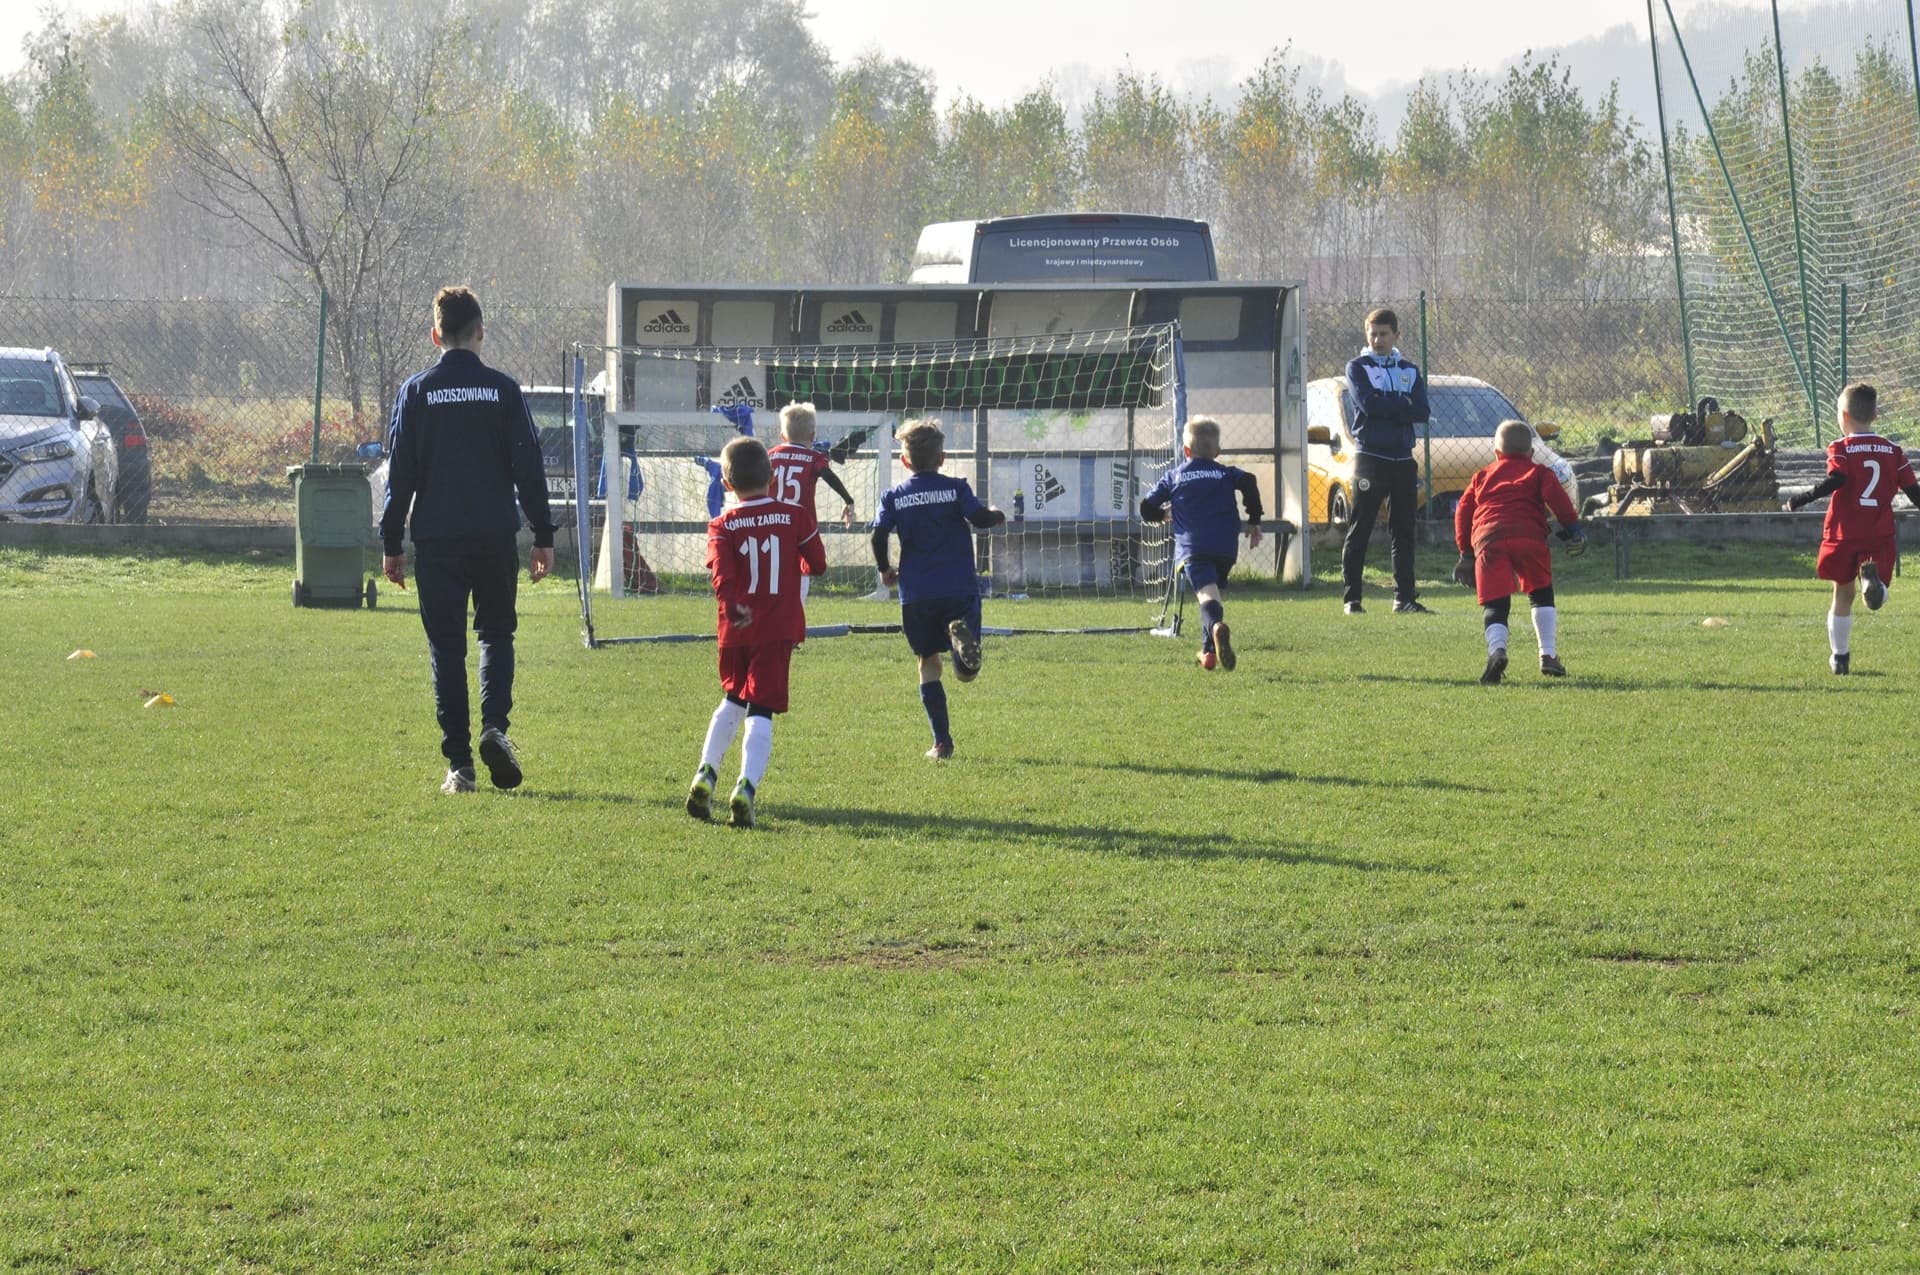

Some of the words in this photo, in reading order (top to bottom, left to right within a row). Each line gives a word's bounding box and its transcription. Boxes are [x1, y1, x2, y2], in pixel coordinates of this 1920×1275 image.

[1009, 237, 1099, 248] Licencjonowany
[1102, 236, 1148, 247] Przewóz
[1151, 236, 1180, 247] Osób
[1045, 258, 1075, 267] krajowy
[1081, 258, 1144, 267] międzynarodowy
[643, 322, 690, 333] adidas
[826, 322, 873, 333] adidas
[775, 354, 1147, 399] GOSPODARZE
[426, 387, 500, 406] RADZISZOWIANKA
[773, 464, 804, 504] 15
[1034, 463, 1046, 511] adidas
[1859, 459, 1881, 507] 2
[894, 488, 958, 511] RADZISZOWIANKA
[1113, 480, 1124, 511] Kable
[756, 513, 791, 526] ZABRZE
[739, 533, 780, 594] 11
